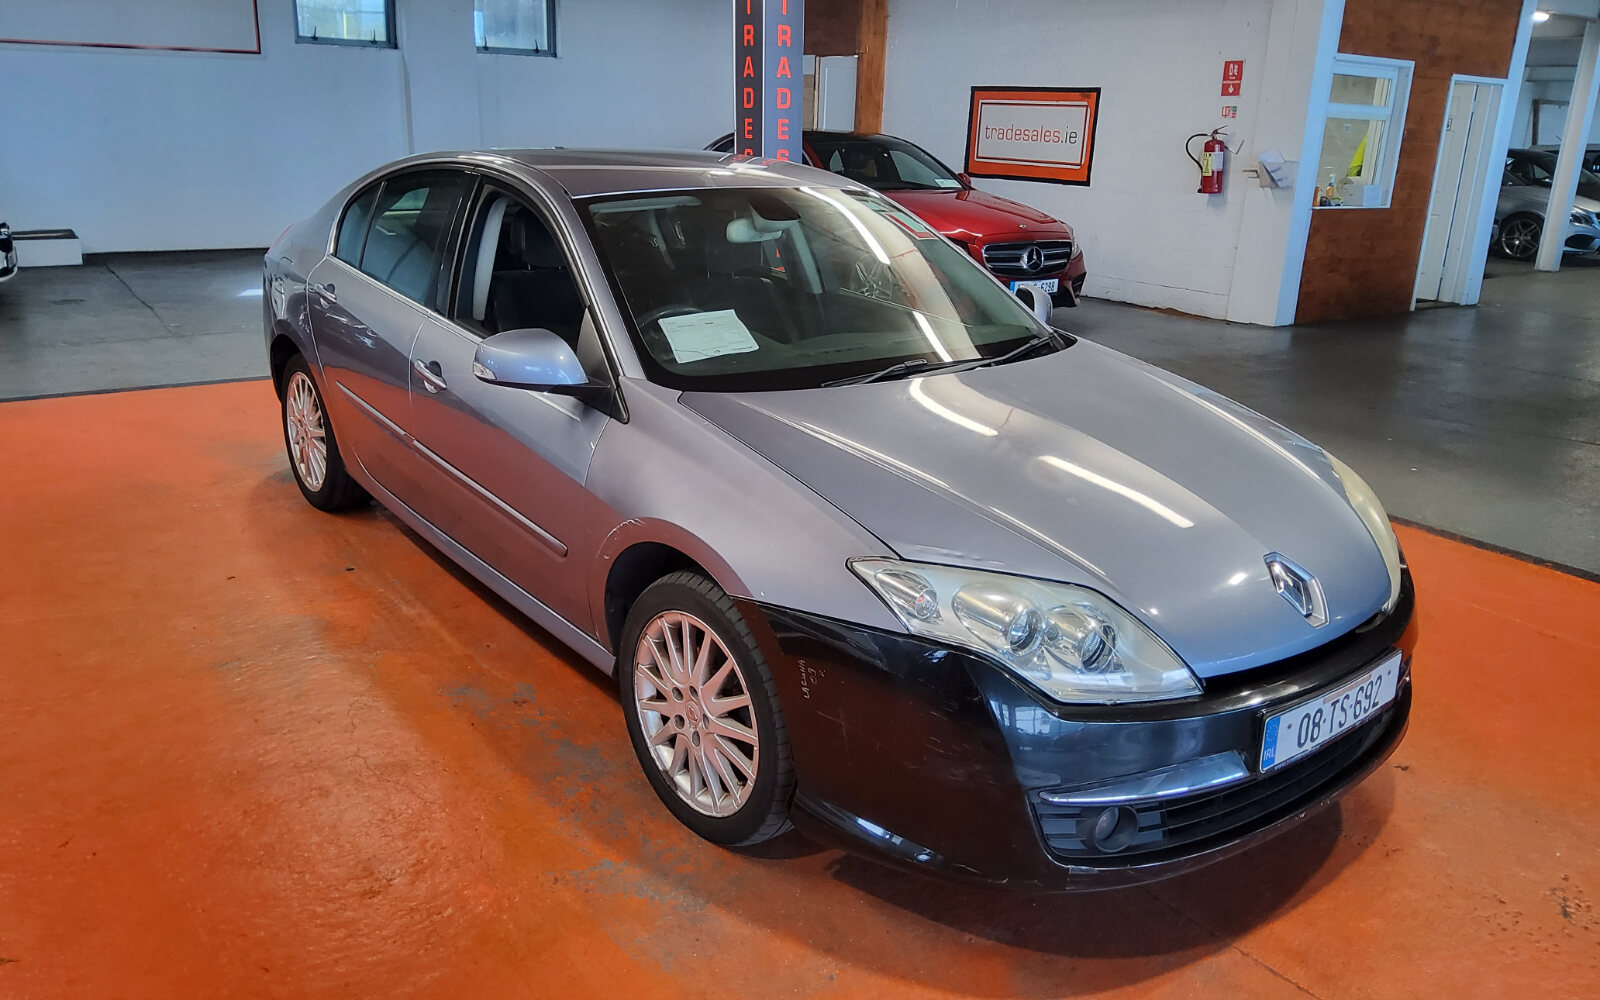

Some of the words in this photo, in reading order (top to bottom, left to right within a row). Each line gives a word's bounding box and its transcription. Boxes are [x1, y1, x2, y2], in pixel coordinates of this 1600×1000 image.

[984, 123, 1078, 145] tradesales.ie
[1297, 674, 1383, 748] 08-TS-692
[1263, 748, 1276, 761] IRL
